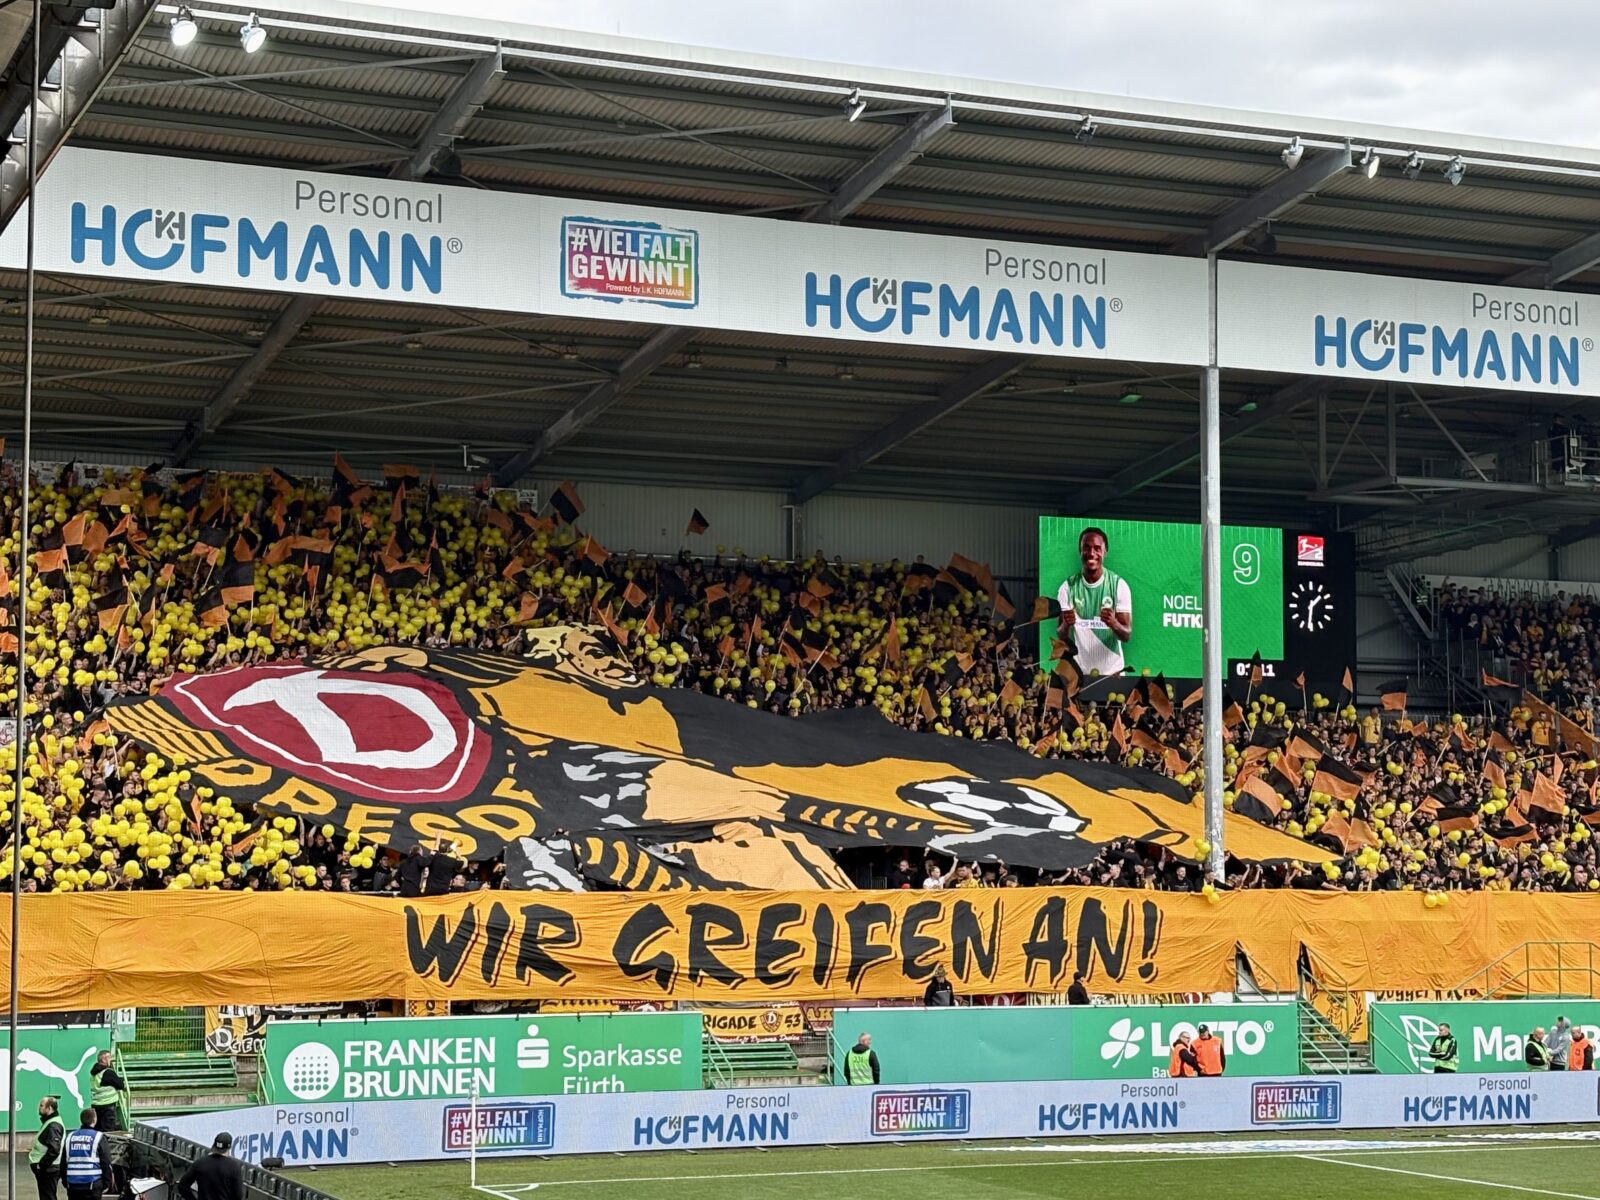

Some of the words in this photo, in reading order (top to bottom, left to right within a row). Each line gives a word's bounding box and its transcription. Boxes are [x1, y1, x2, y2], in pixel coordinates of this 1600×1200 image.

[295, 180, 443, 224] Personal
[570, 227, 690, 262] #VIELFALT
[571, 253, 689, 288] GEWINNT
[985, 248, 1107, 285] Personal
[605, 282, 632, 293] Powered
[632, 285, 641, 295] by
[1472, 292, 1579, 327] Personal
[1232, 543, 1261, 586] 9
[1163, 594, 1203, 611] NOEL
[1162, 612, 1204, 628] FUTK
[403, 901, 583, 988] WIR
[611, 897, 1006, 996] GREIFEN
[1021, 895, 1165, 989] AN!
[784, 1013, 801, 1028] 53
[343, 1036, 496, 1068] FRANKEN
[562, 1043, 682, 1075] Sparkasse
[343, 1067, 496, 1098] BRUNNEN
[562, 1076, 625, 1094] Fürth
[1121, 1082, 1179, 1098] Personal
[1478, 1076, 1532, 1091] Personal
[726, 1092, 791, 1109] Personal
[1257, 1087, 1320, 1103] #VIELFALT
[877, 1096, 947, 1113] #VIELFALT
[1257, 1102, 1320, 1119] GEWINNT
[276, 1107, 349, 1125] Personal
[450, 1109, 529, 1128] #VELFALT
[878, 1112, 947, 1130] GEWINNT
[231, 1127, 349, 1164] OFMANN
[450, 1127, 528, 1146] GEWINNT
